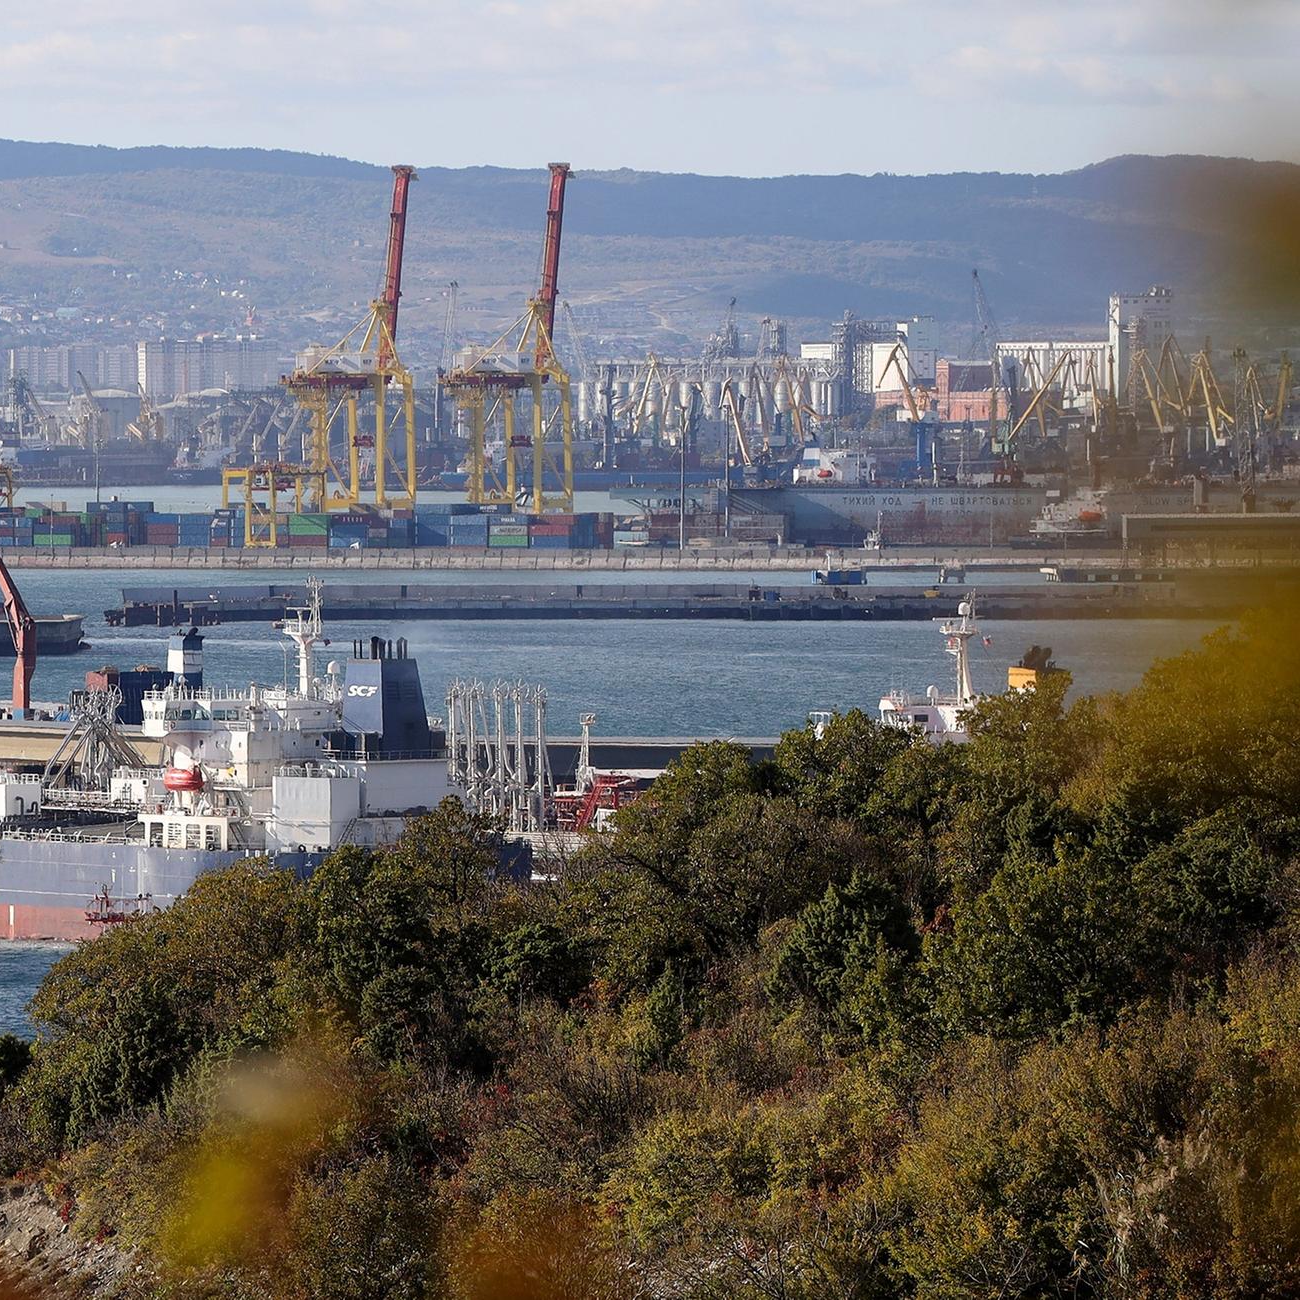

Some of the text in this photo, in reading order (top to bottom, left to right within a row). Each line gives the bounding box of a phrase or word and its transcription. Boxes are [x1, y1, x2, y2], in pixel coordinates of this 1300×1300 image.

[843, 495, 876, 506] ТИХИЙ
[882, 496, 903, 506] ХОД
[931, 496, 944, 506] НЕ
[950, 496, 1033, 506] ШВАРТОВАТЬСЯ
[347, 685, 378, 697] SCF
